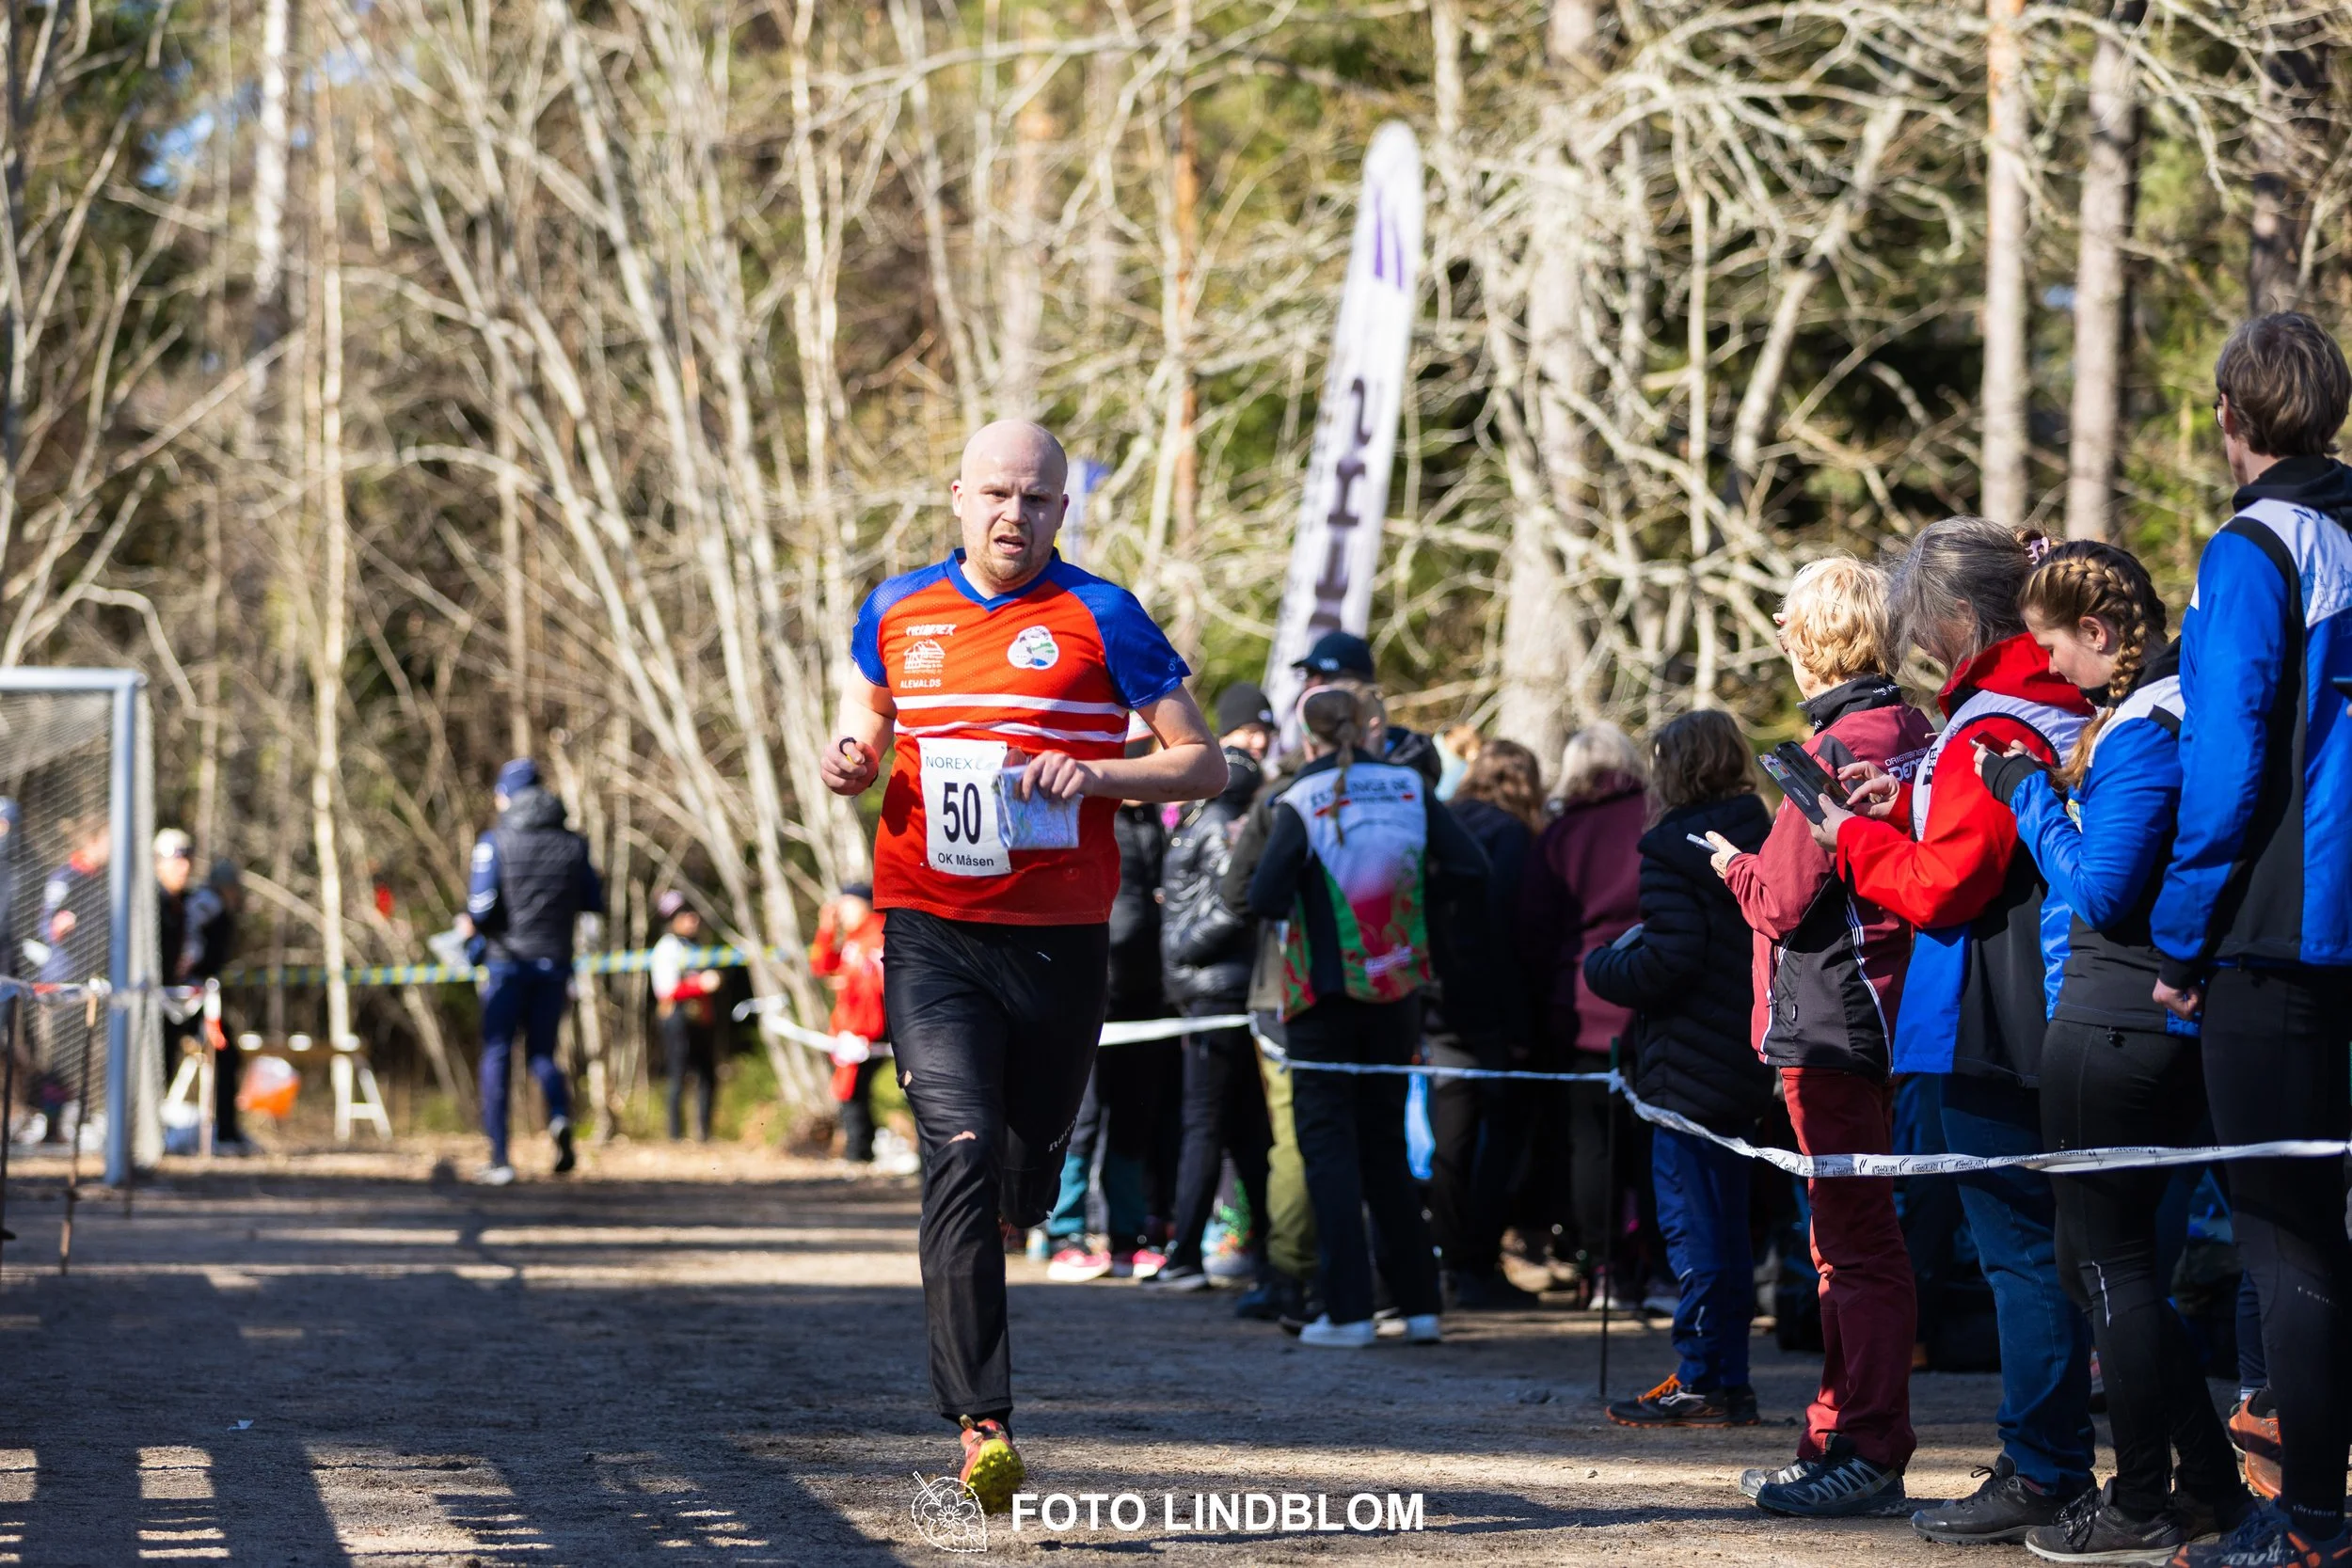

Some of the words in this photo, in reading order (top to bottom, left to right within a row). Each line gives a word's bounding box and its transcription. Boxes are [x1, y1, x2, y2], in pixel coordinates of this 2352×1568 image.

[926, 756, 973, 769] NOREX
[943, 782, 981, 845] 50
[938, 852, 953, 864] OK
[956, 854, 994, 866] Måsen
